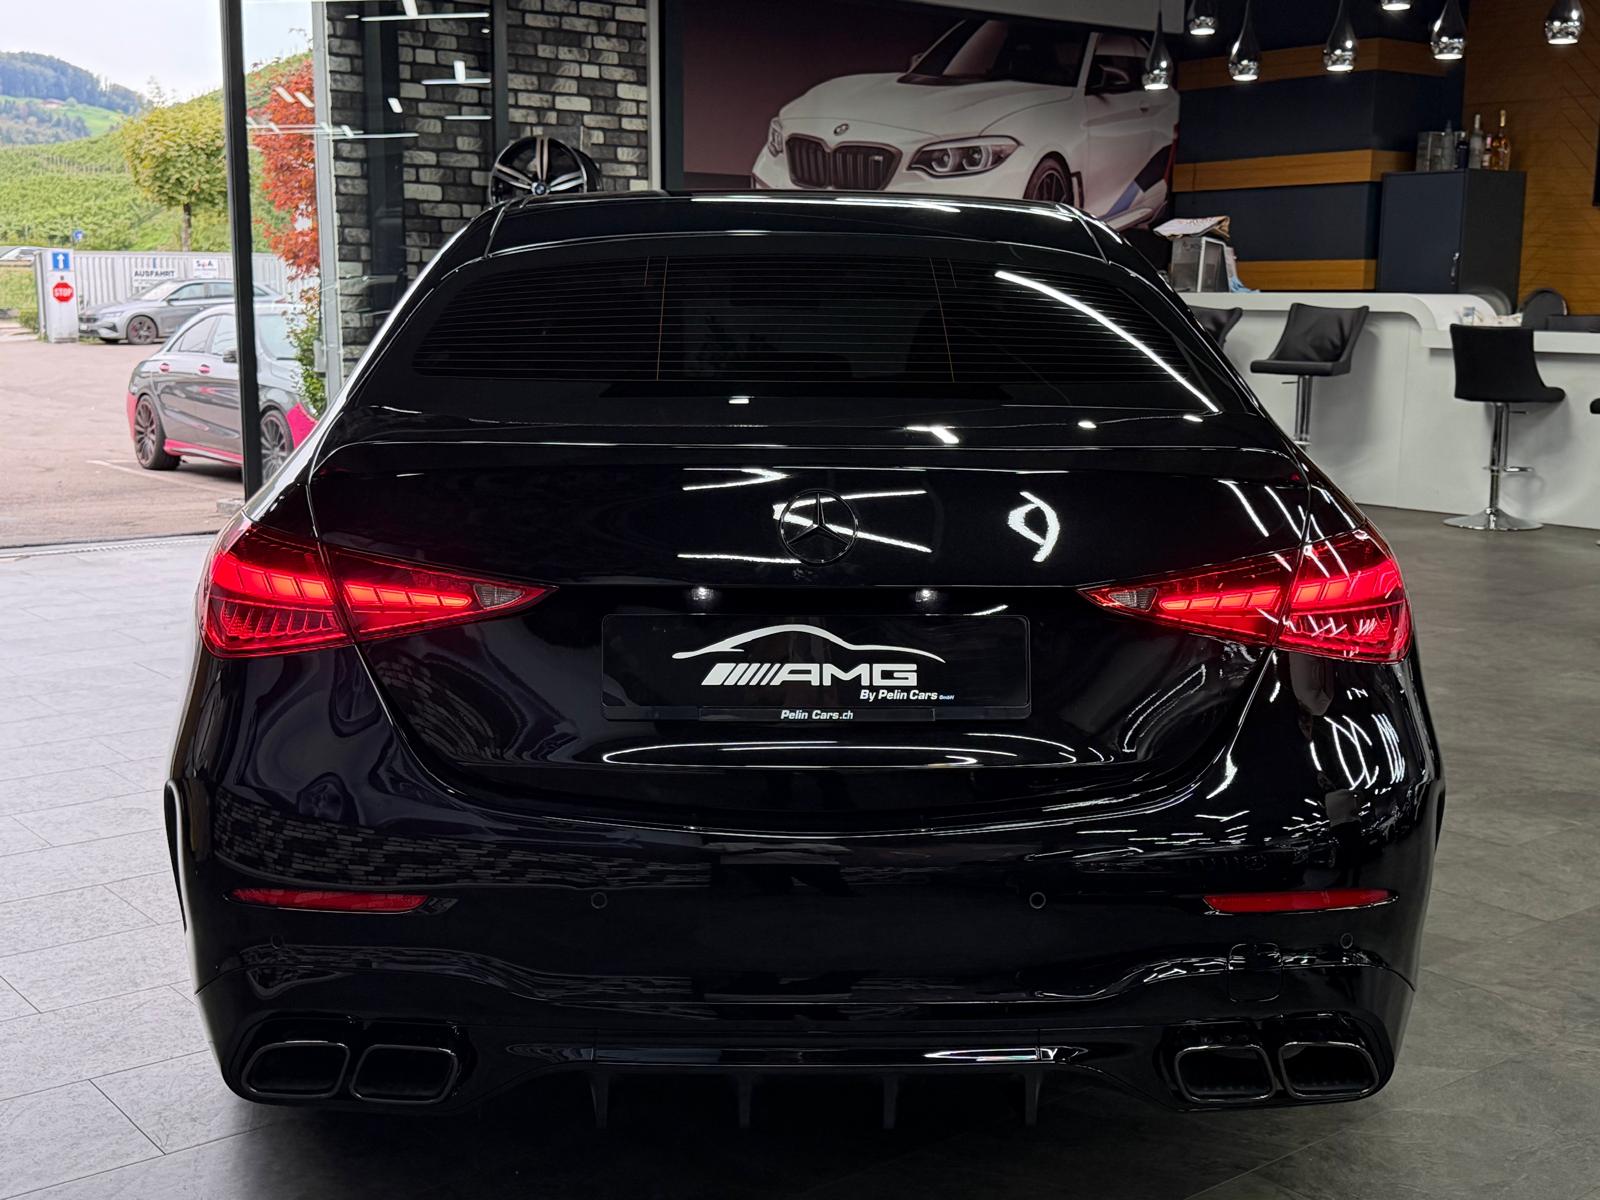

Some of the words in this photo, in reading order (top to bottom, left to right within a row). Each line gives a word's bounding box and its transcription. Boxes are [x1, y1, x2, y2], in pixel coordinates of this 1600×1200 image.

[54, 287, 73, 297] STOP
[769, 663, 917, 686] AMG
[860, 689, 876, 702] By
[878, 689, 907, 700] Pelin
[909, 689, 938, 700] Cars
[780, 709, 808, 720] Pelin
[811, 709, 854, 720] Cars.ch
